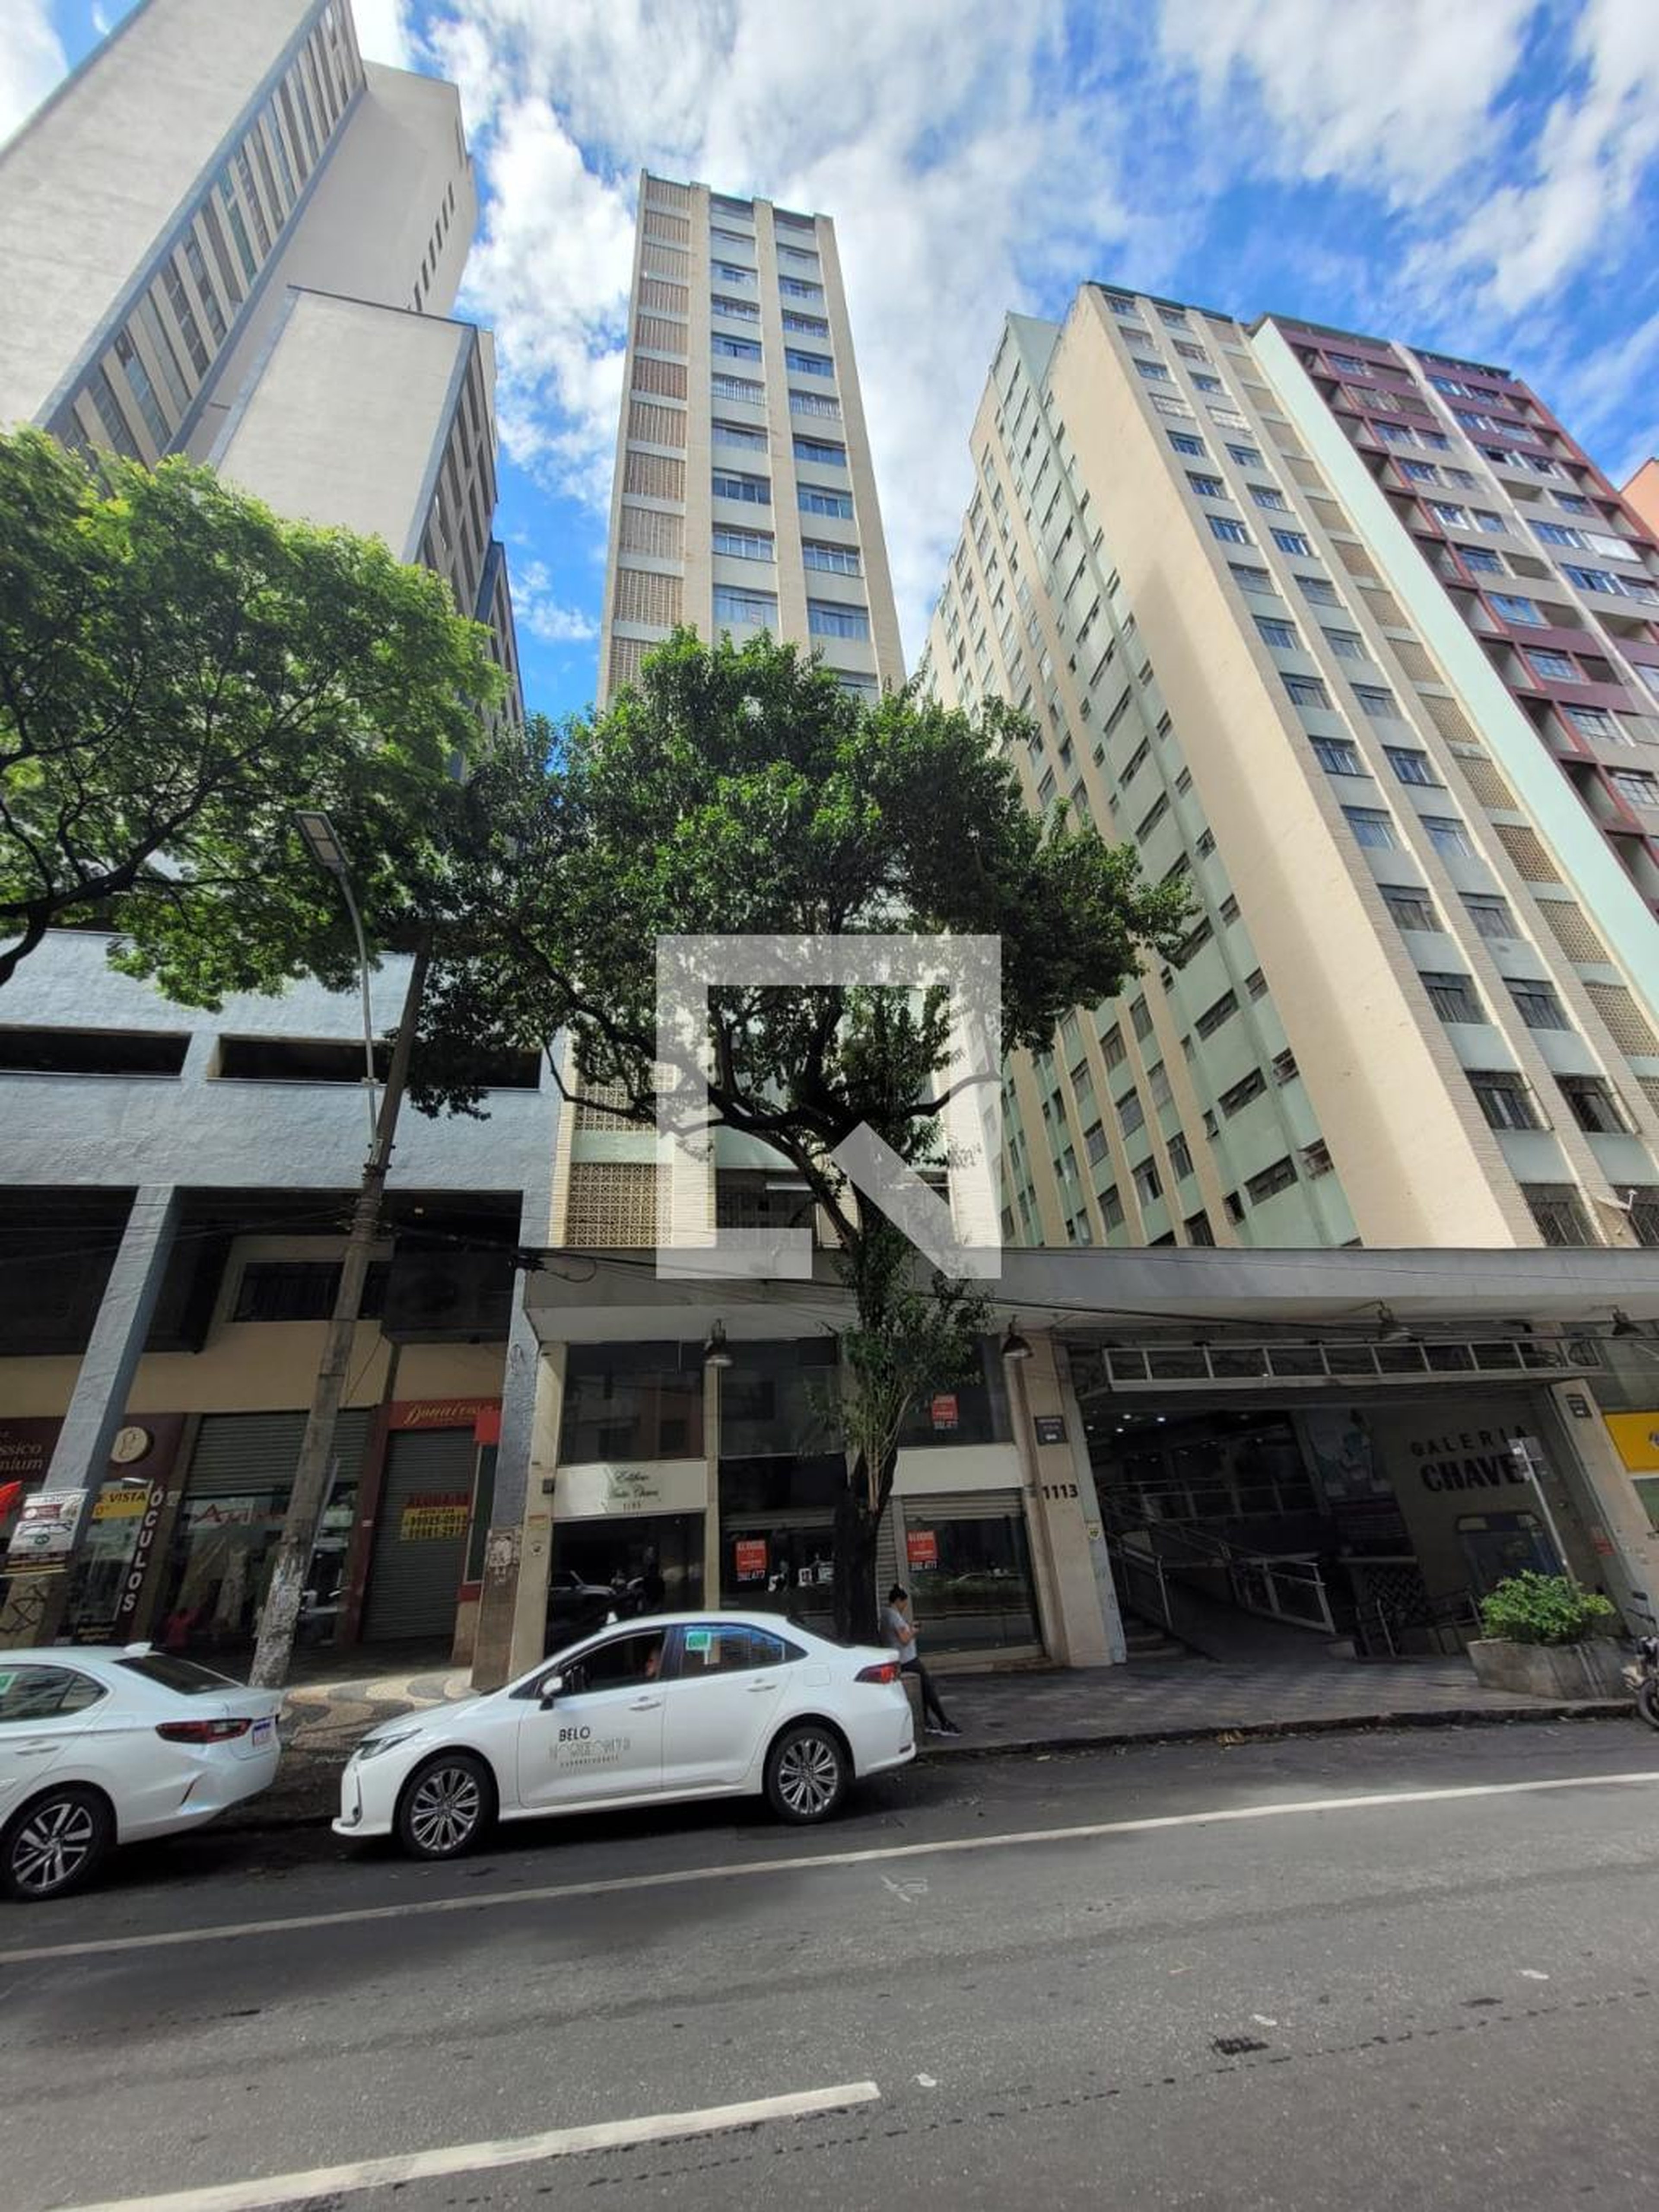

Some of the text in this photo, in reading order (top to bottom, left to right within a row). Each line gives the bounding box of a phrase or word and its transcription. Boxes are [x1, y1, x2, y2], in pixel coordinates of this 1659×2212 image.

[1410, 1425, 1530, 1457] GALERIA
[1420, 1452, 1540, 1492] CHAVE
[109, 1490, 146, 1503] VISTA
[1042, 1484, 1078, 1500] 1113
[122, 1486, 164, 1612] ÓCULOS
[558, 1726, 591, 1742] BELO
